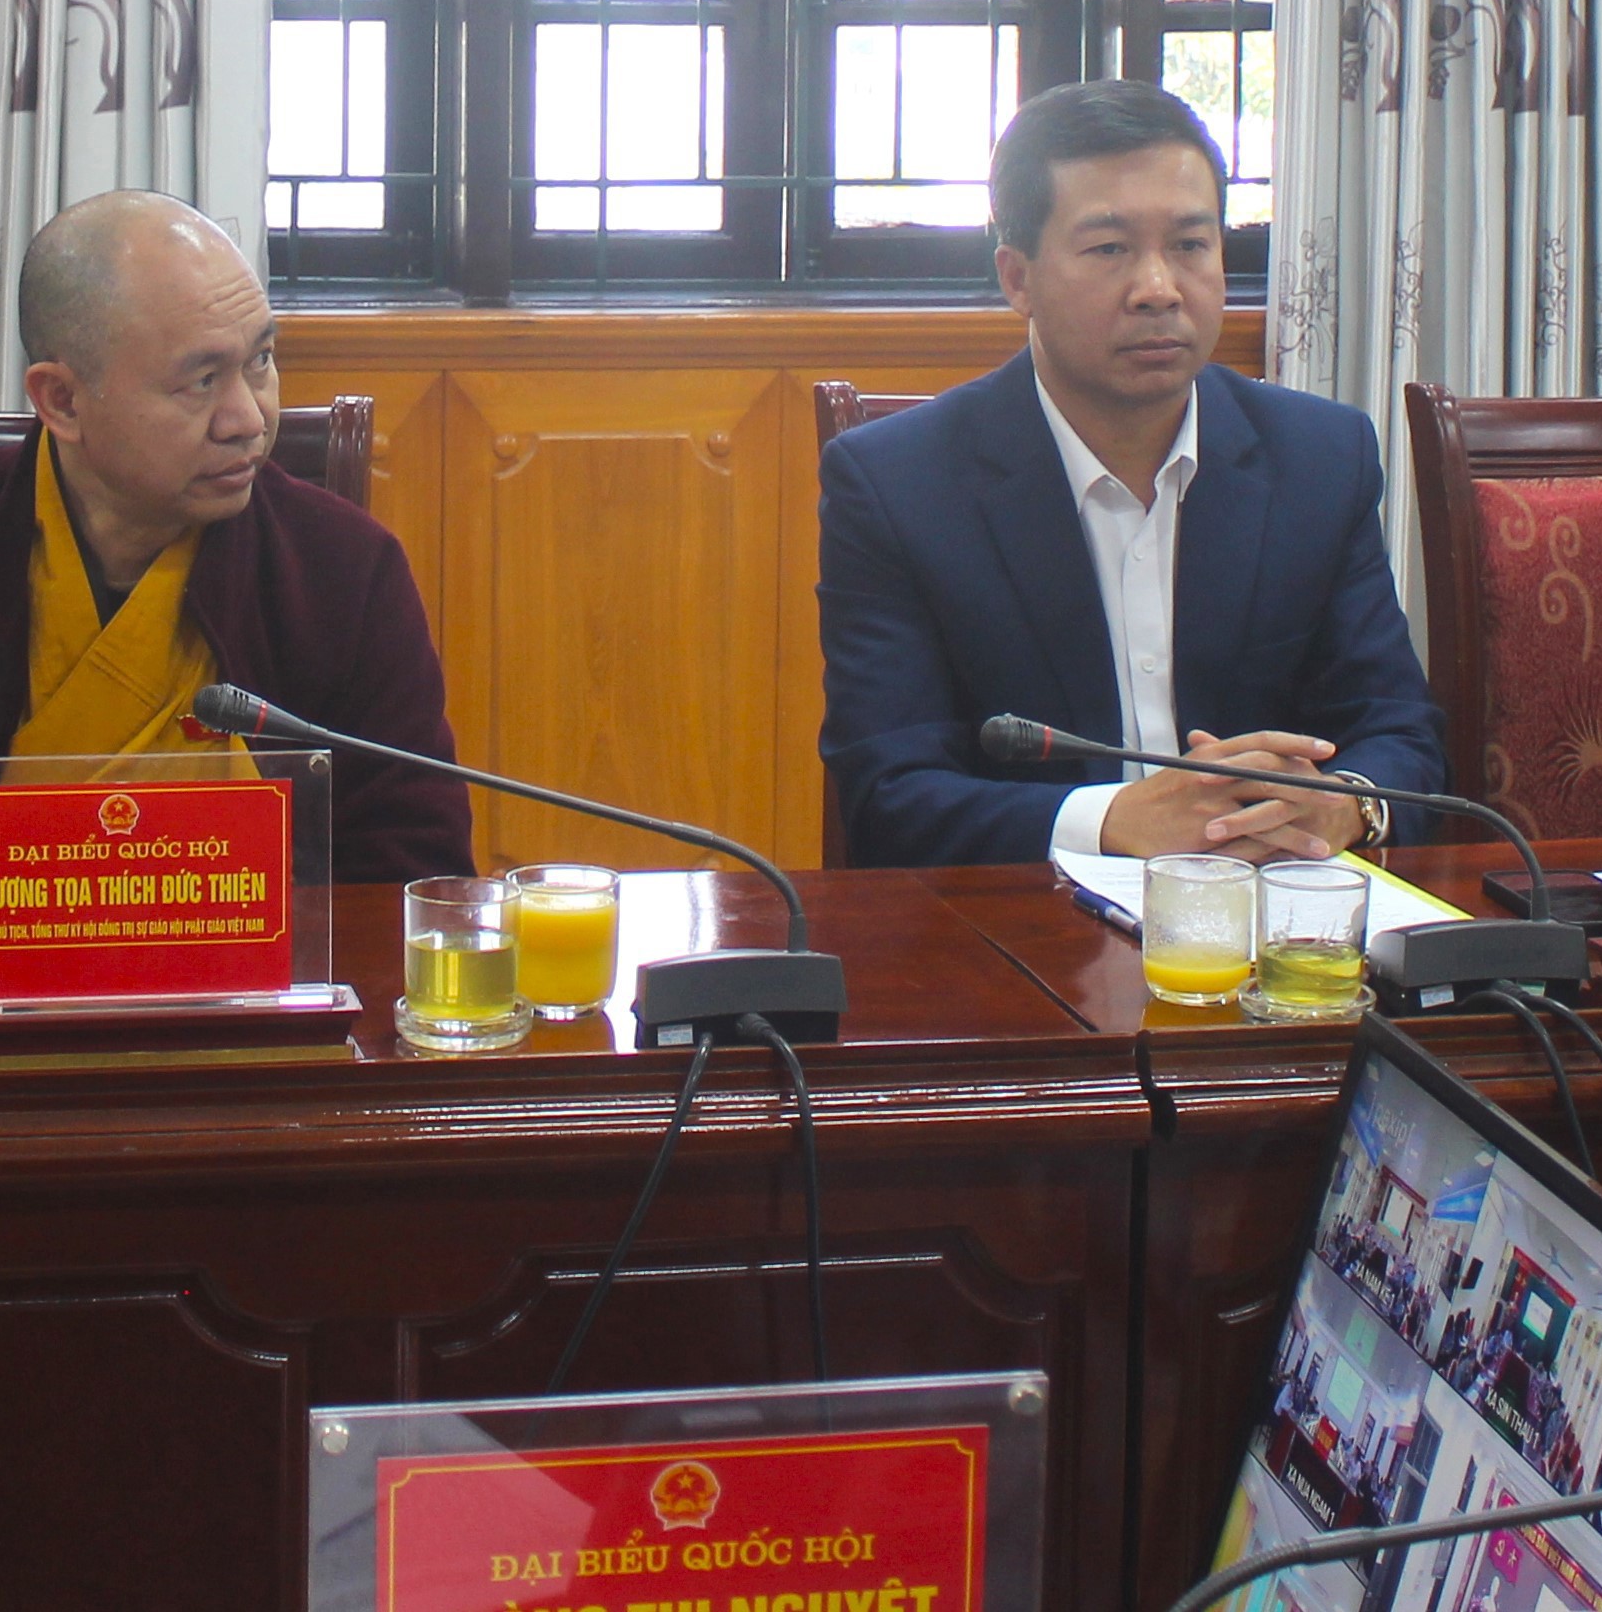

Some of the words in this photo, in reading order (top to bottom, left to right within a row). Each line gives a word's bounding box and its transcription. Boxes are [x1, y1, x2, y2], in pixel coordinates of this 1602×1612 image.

[8, 846, 48, 866] ĐẠI
[58, 834, 110, 861] BIỂU
[118, 834, 181, 860] QUỐC
[188, 836, 229, 862] HỘI
[55, 877, 92, 914] TỌA
[98, 869, 156, 906] THÍCH
[162, 867, 202, 904] ĐỨC
[209, 866, 266, 907] THIỆN
[491, 1552, 562, 1587] ĐẠI
[577, 1528, 670, 1577] BIỂU
[683, 1527, 792, 1572] QUỐC
[804, 1527, 875, 1570] HỘI
